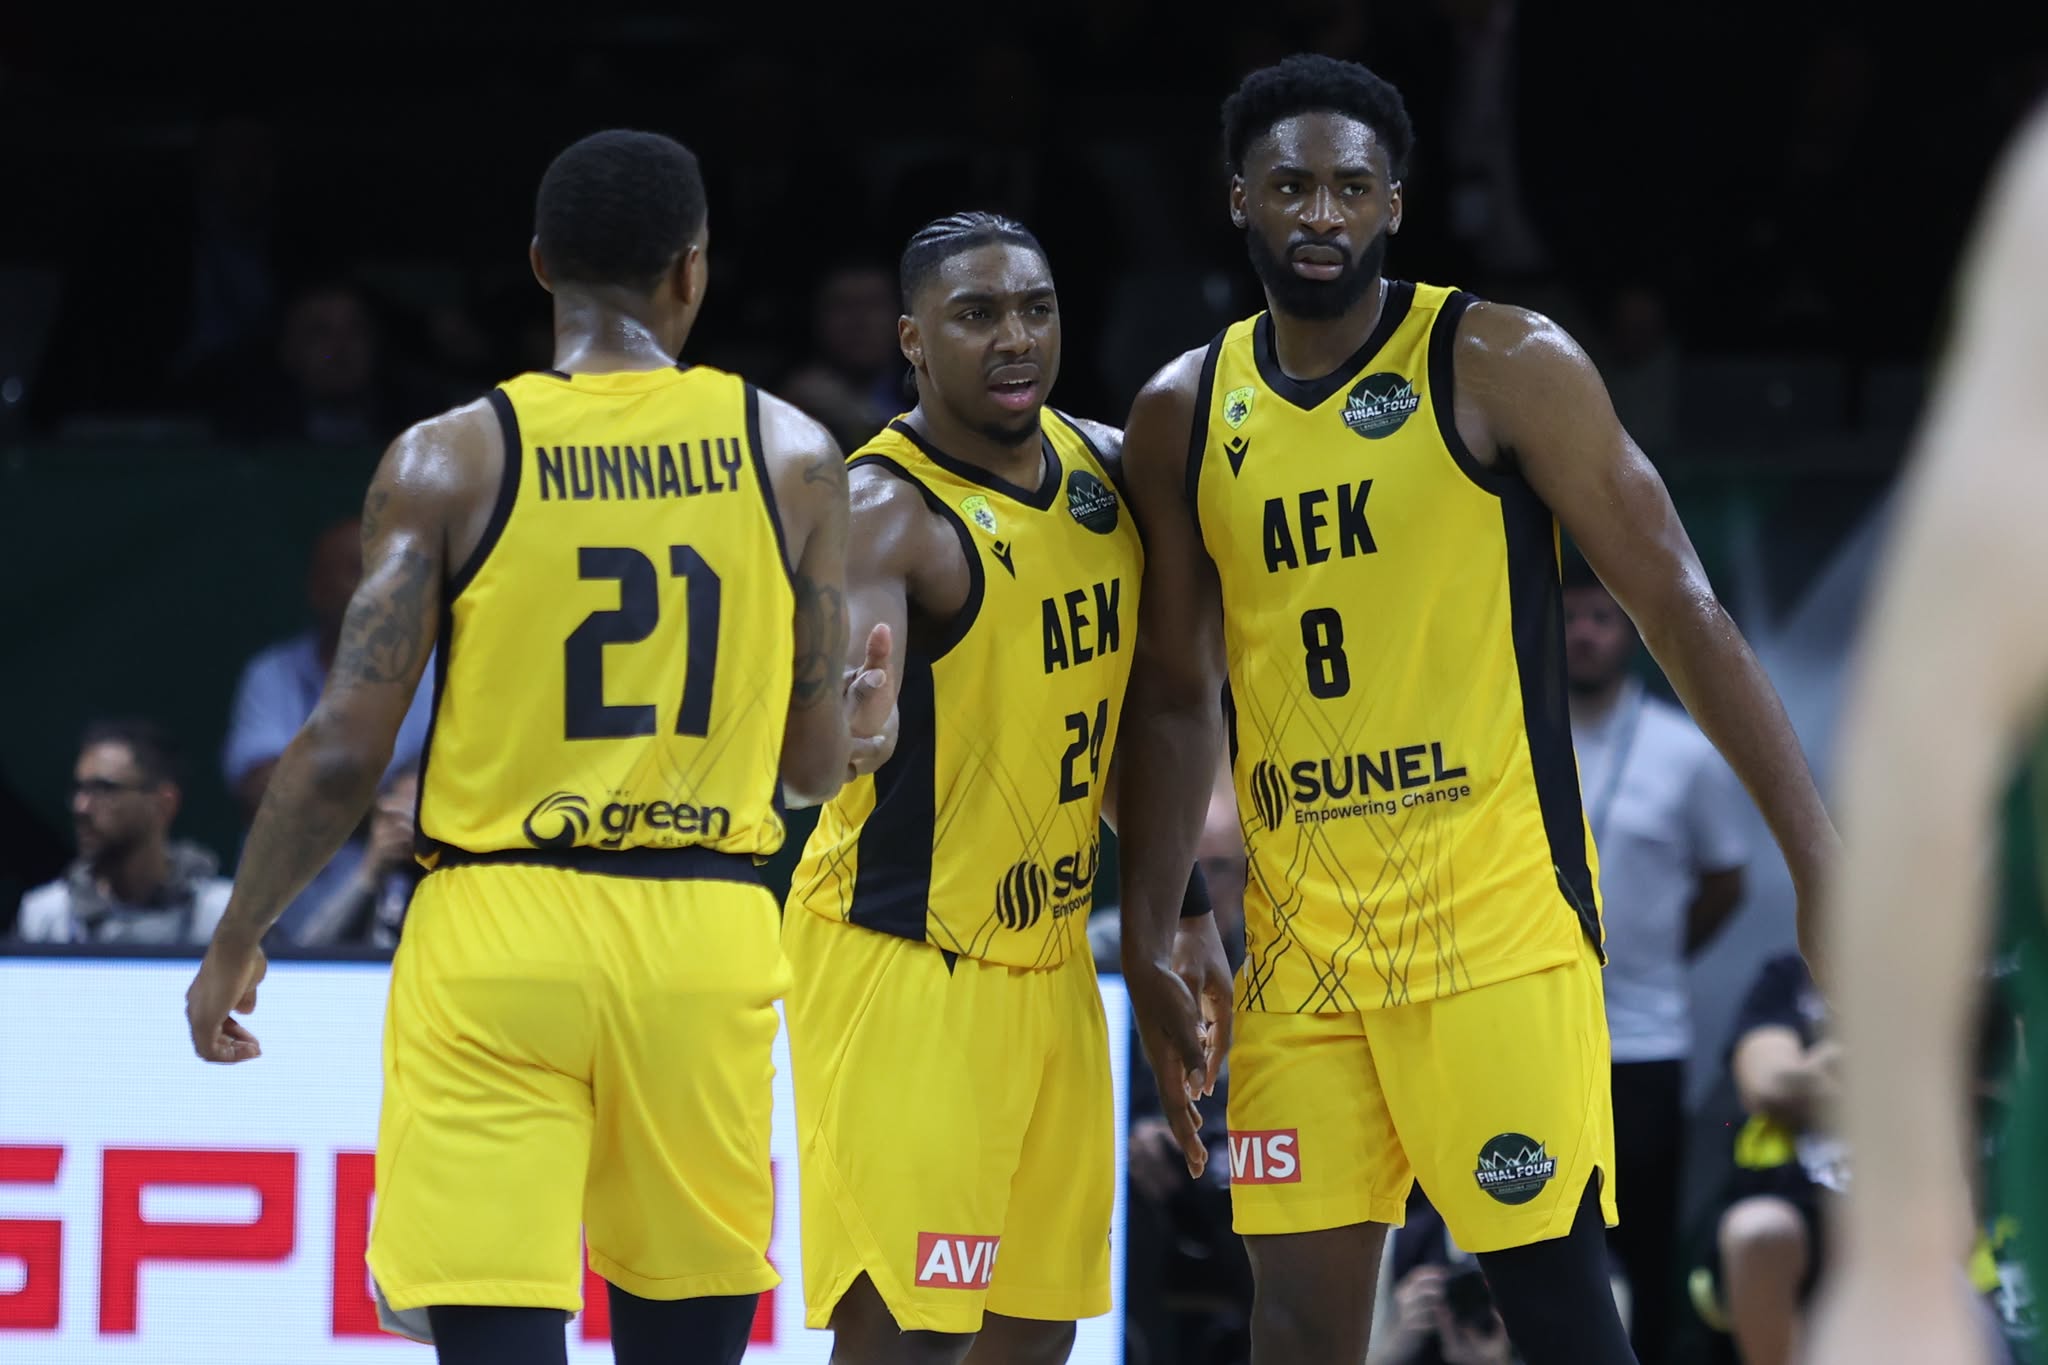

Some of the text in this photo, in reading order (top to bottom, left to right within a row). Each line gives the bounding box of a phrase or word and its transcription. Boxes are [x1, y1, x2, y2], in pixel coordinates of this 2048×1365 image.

[1344, 397, 1418, 422] FINAL FOUR
[535, 437, 742, 500] NUNNALLY
[1262, 478, 1378, 573] AEK
[564, 545, 721, 741] 21
[1042, 577, 1120, 674] AEK
[1300, 607, 1351, 700] 8
[1058, 698, 1109, 804] 24
[1290, 742, 1467, 803] SUNEL
[601, 800, 730, 848] green
[1294, 783, 1471, 824] Empowering Change
[1230, 1134, 1296, 1178] VIS
[1477, 1161, 1553, 1183] FINAL FOUR
[918, 1239, 1000, 1284] AVI
